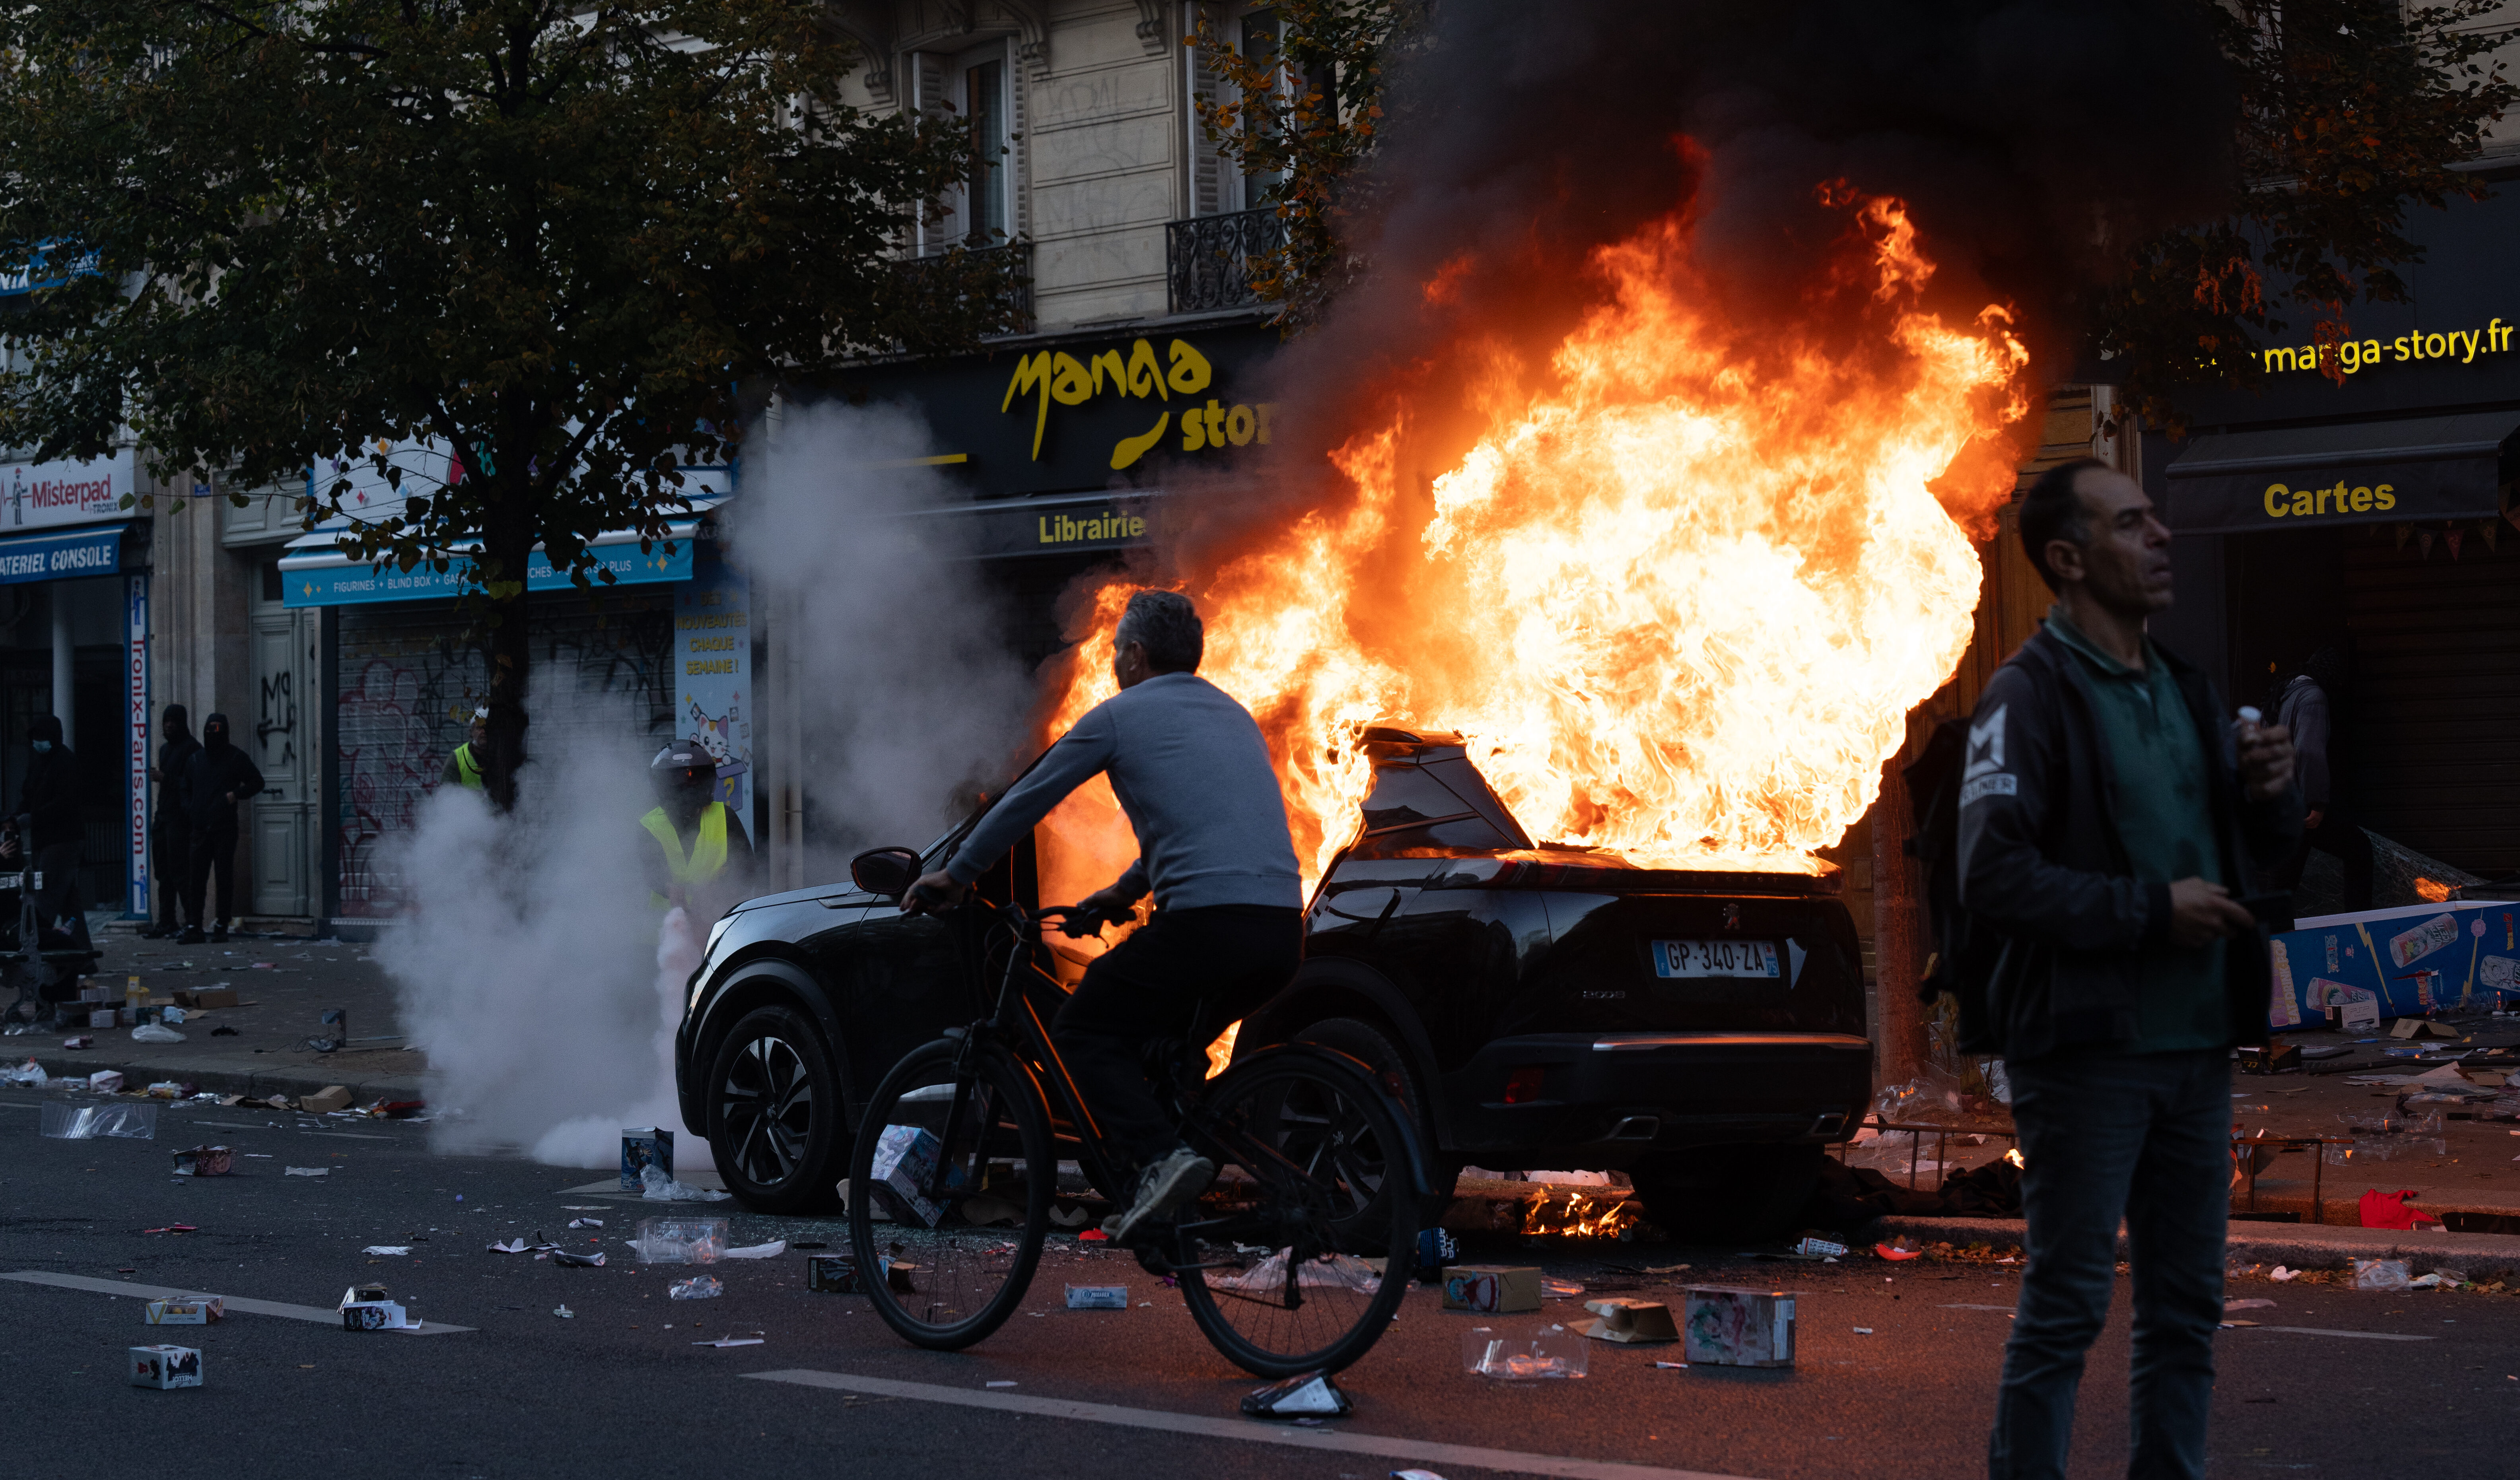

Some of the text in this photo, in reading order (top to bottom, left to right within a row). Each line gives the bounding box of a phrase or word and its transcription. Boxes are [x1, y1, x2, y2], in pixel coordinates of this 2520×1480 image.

[1181, 399, 1276, 451] stor
[32, 474, 111, 511] Misterpad
[2264, 480, 2396, 517] Cartes
[93, 501, 118, 513] TRONIX
[1039, 509, 1146, 543] Librairie
[51, 545, 111, 571] CONSOLE
[333, 579, 375, 593] FIGURINES
[387, 577, 412, 590] BLIND
[414, 576, 431, 588] BOX
[527, 566, 552, 579] CHES
[609, 559, 632, 573] PLUS
[700, 591, 721, 606] DES
[675, 610, 747, 629] NOUVEAUTÉS
[689, 635, 734, 652] CHAQUE
[686, 658, 733, 675] SEMAINE
[132, 634, 146, 855] Tronix-Paris.com
[1668, 943, 1765, 971] GP-340-ZA
[1767, 959, 1778, 975] 75
[172, 1374, 192, 1383] HELLO!
